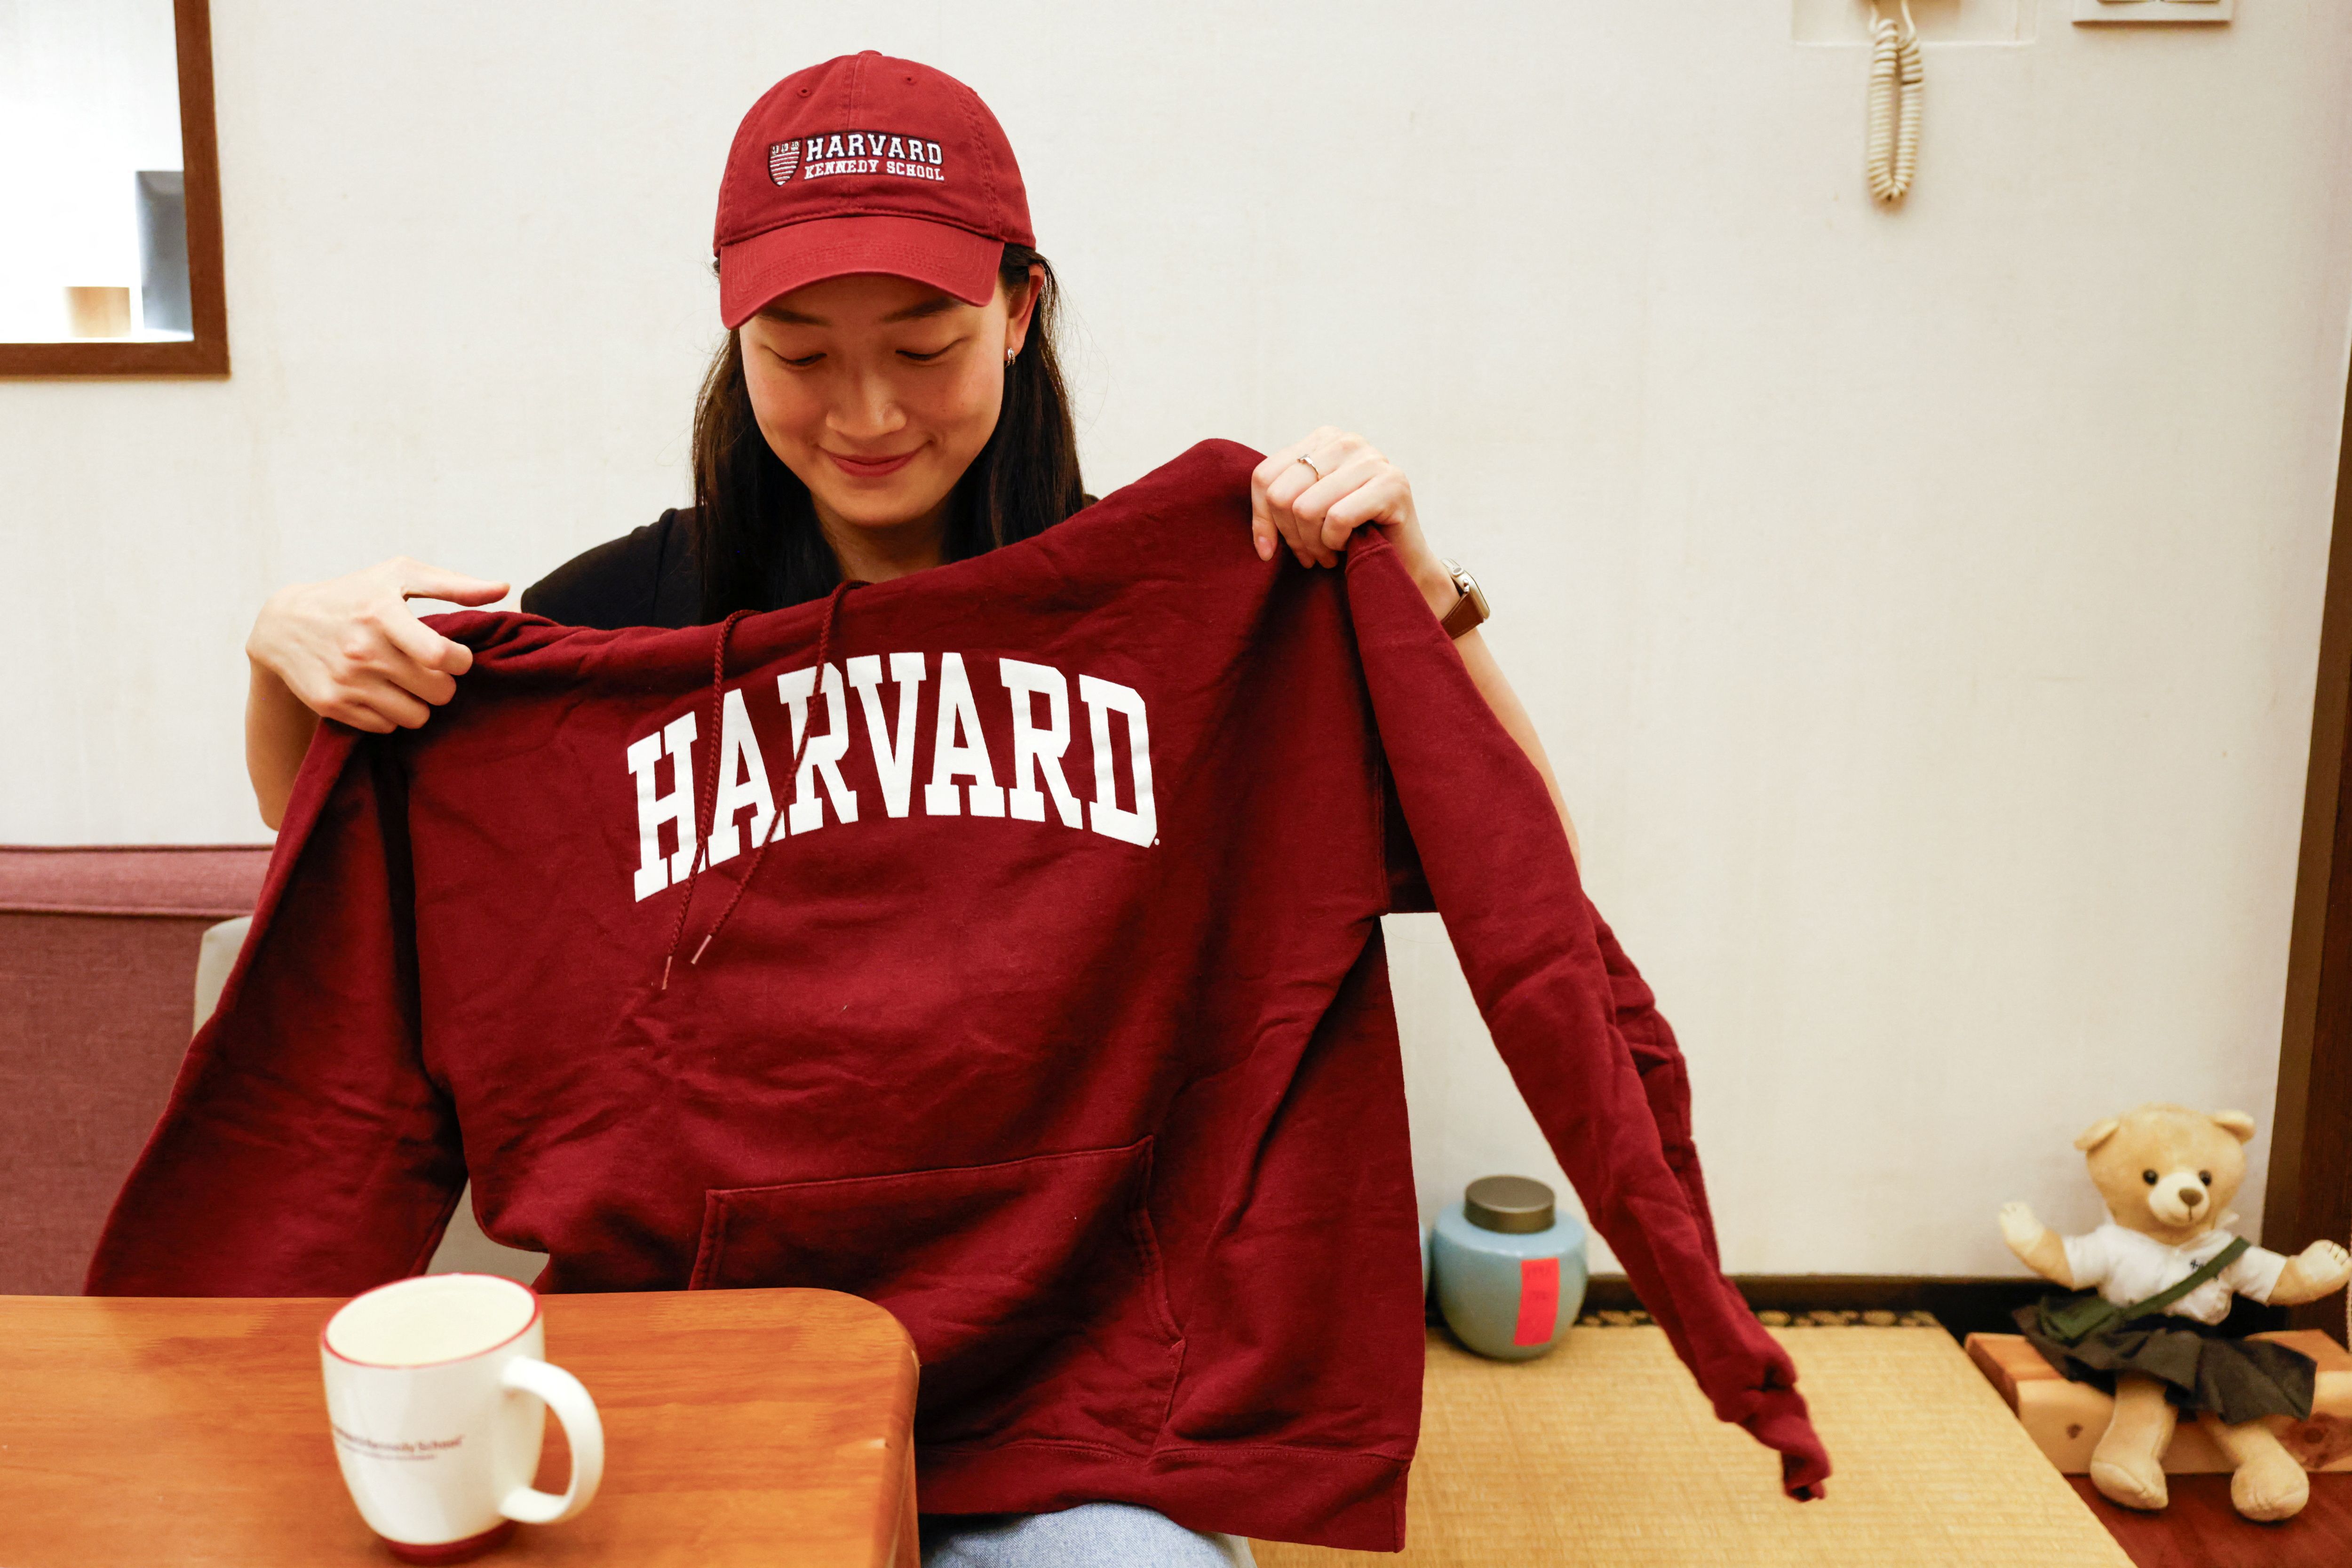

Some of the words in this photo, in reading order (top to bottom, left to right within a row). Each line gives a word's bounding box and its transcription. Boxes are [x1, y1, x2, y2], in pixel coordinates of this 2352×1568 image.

[806, 133, 943, 164] HARVARD
[804, 160, 879, 179] KENNEDY
[886, 162, 945, 181] SCHOOL
